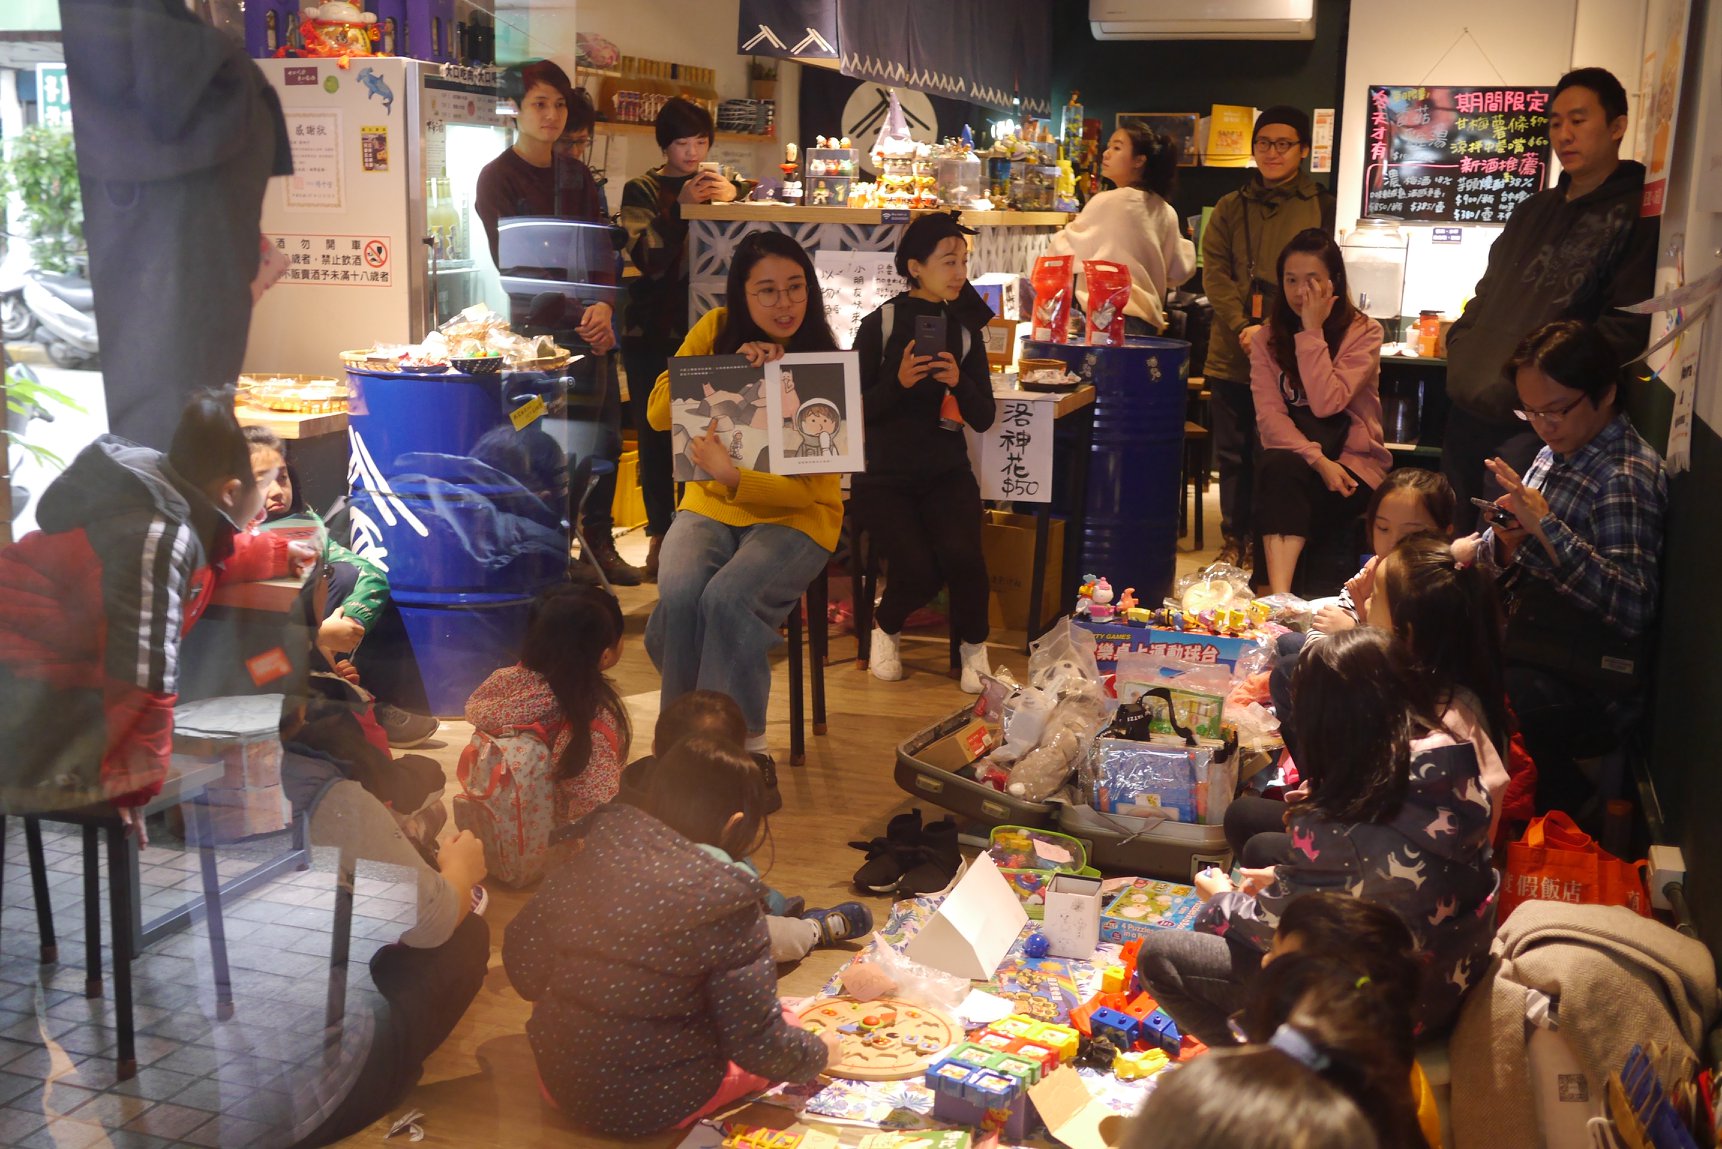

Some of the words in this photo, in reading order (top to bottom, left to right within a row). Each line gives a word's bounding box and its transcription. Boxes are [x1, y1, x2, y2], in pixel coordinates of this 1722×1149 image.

[1454, 91, 1549, 113] 期間限定
[1460, 152, 1539, 175] 新酒推薦
[999, 403, 1033, 478] 洛神花
[1002, 477, 1039, 498] $50
[1095, 641, 1219, 664] 樂桌上運動球台
